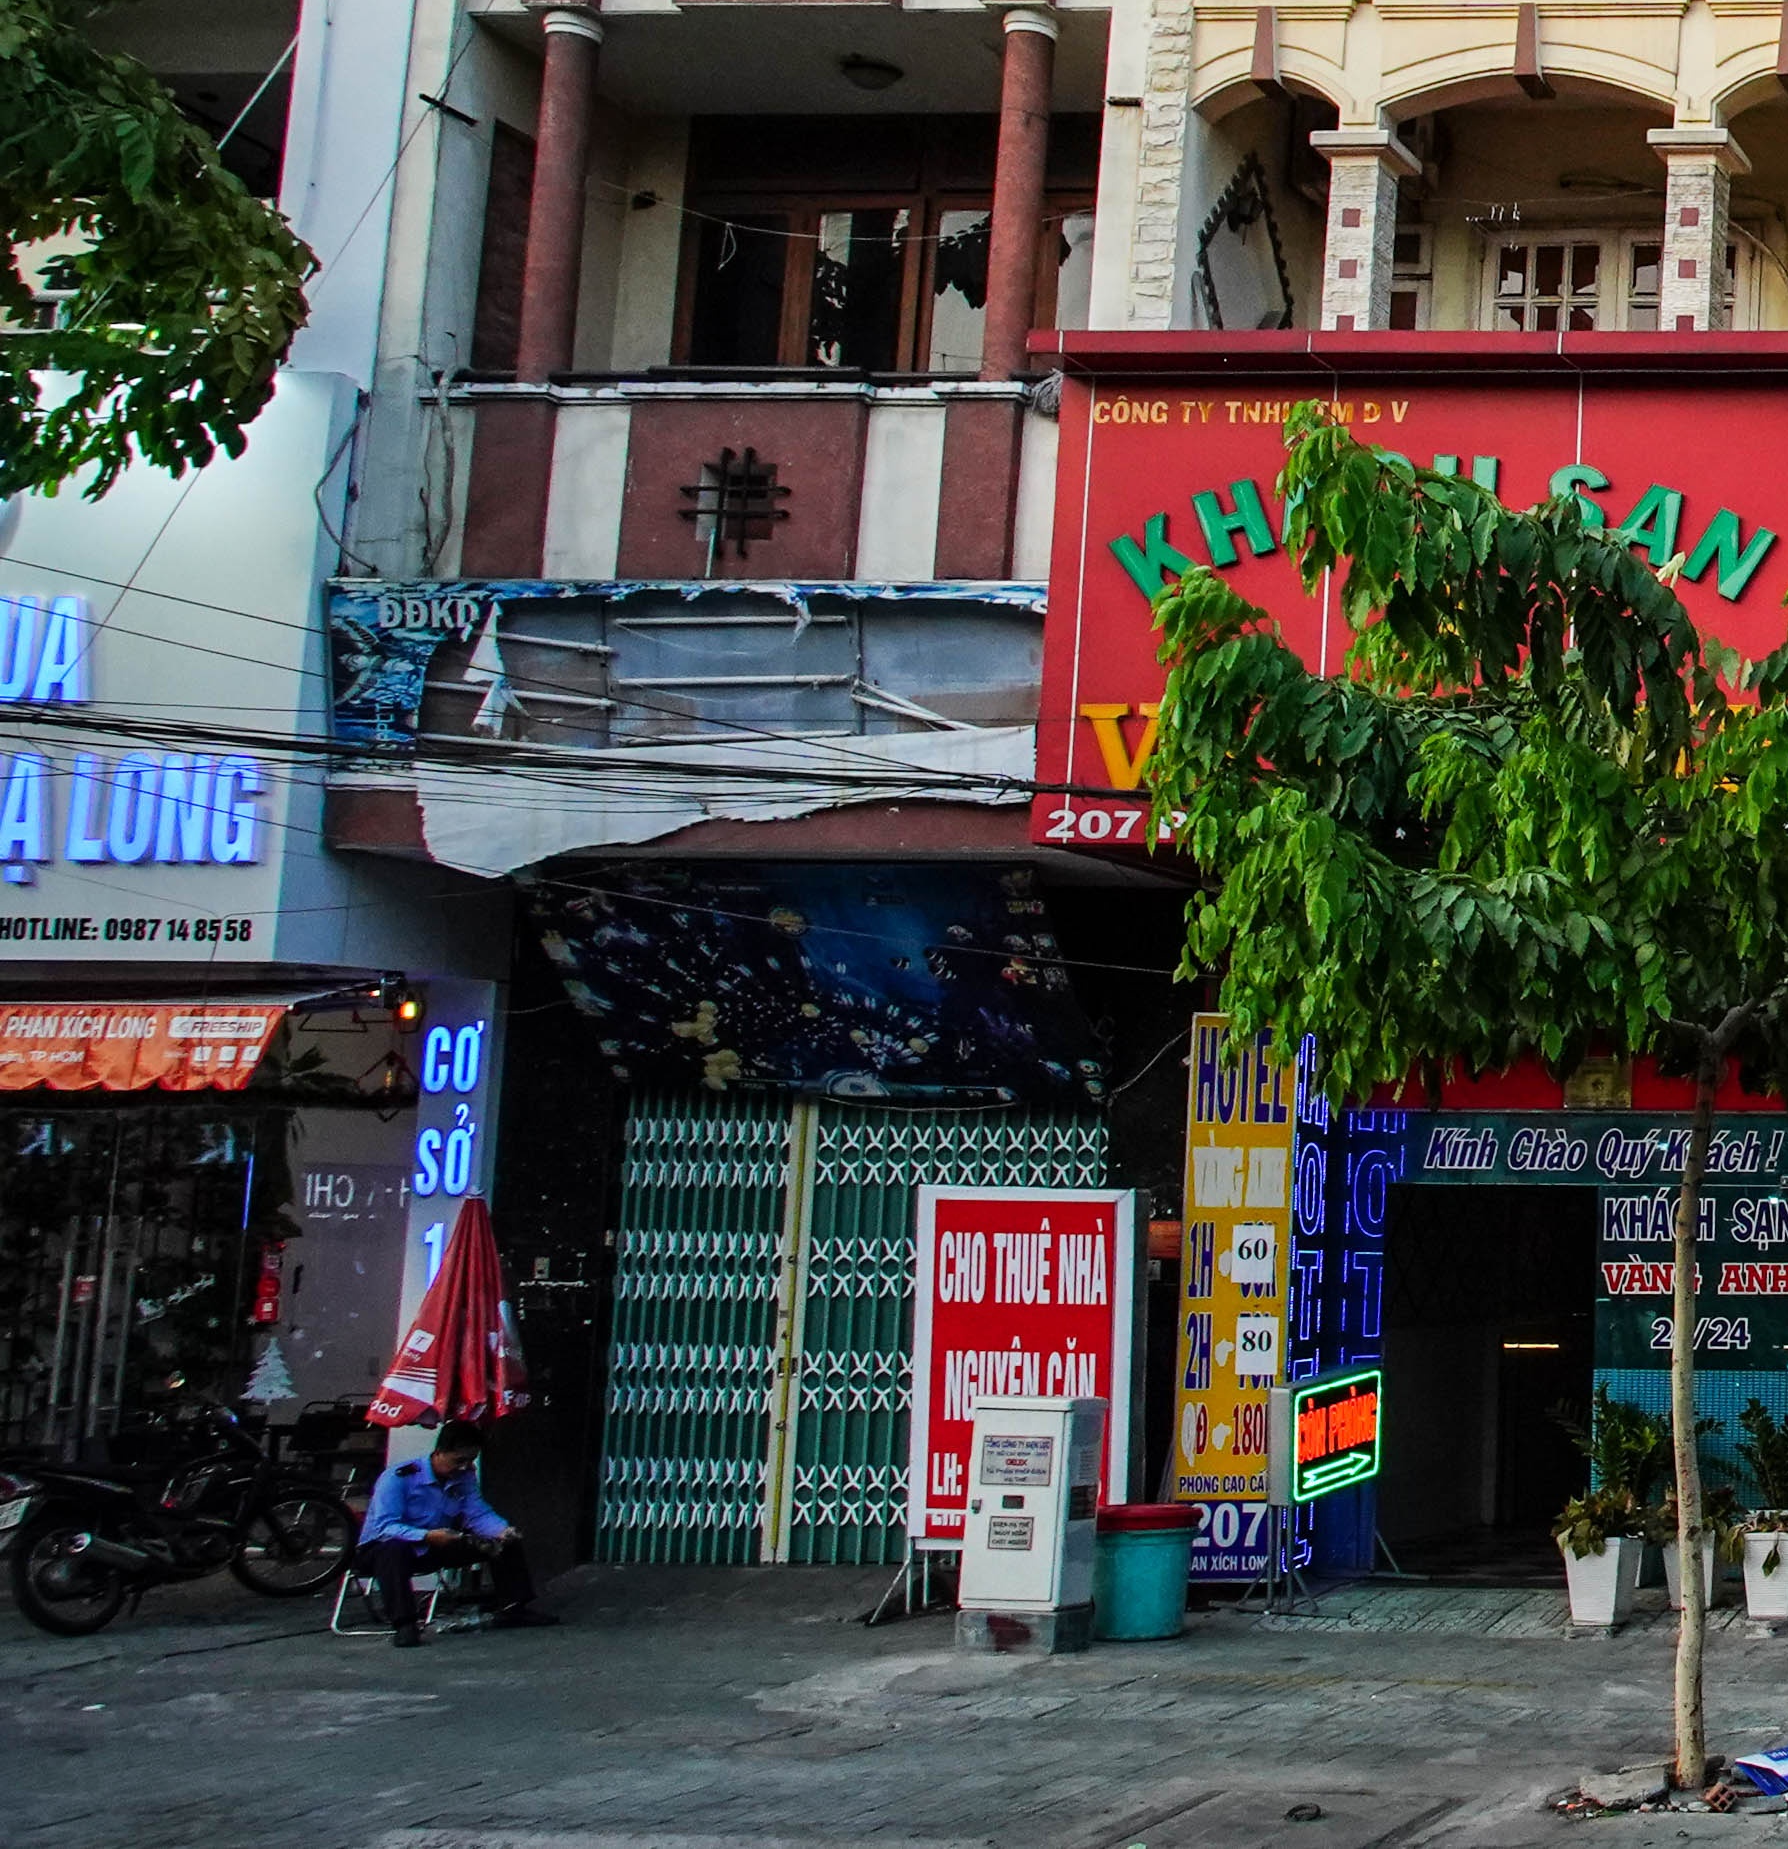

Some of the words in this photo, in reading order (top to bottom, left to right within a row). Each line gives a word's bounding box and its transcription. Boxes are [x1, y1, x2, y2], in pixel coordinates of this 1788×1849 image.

[1094, 396, 1169, 424] CÔNG
[1180, 401, 1214, 424] TY
[63, 751, 263, 864] LONG
[1045, 809, 1143, 840] 207
[0, 918, 99, 942] HOTLINE:
[104, 917, 160, 942] 0987
[166, 918, 190, 942] 14
[194, 918, 223, 942] 85
[224, 918, 254, 942] 58
[4, 1016, 61, 1039] PHAN
[60, 1010, 107, 1039] XÍCH
[106, 1016, 157, 1039] LONG
[191, 1021, 263, 1034] FREESHIP
[422, 1020, 485, 1094] CƠ
[414, 1102, 475, 1197] SỞ
[1424, 1127, 1499, 1170] Kính
[1508, 1128, 1588, 1172] Chào
[1597, 1127, 1659, 1179] Quý
[1660, 1129, 1762, 1173] Kách
[424, 1221, 446, 1290] 1
[938, 1230, 987, 1304] CHO
[993, 1217, 1052, 1305] THUÊ
[1057, 1217, 1107, 1305] NHÀ
[1187, 1221, 1215, 1299] 1H
[1237, 1237, 1268, 1261] 60
[1602, 1253, 1702, 1295] VÀN
[1184, 1312, 1212, 1391] 2H
[1241, 1329, 1272, 1352] 80
[1650, 1316, 1751, 1350] 2/24
[944, 1335, 1041, 1422] NGUYÊN
[1046, 1336, 1097, 1398] CĂN
[1231, 1402, 1269, 1457] 180
[932, 1452, 963, 1497] LH:
[1222, 1475, 1246, 1493] CAO
[1191, 1502, 1269, 1548] 207
[1210, 1550, 1240, 1572] XÍCH
